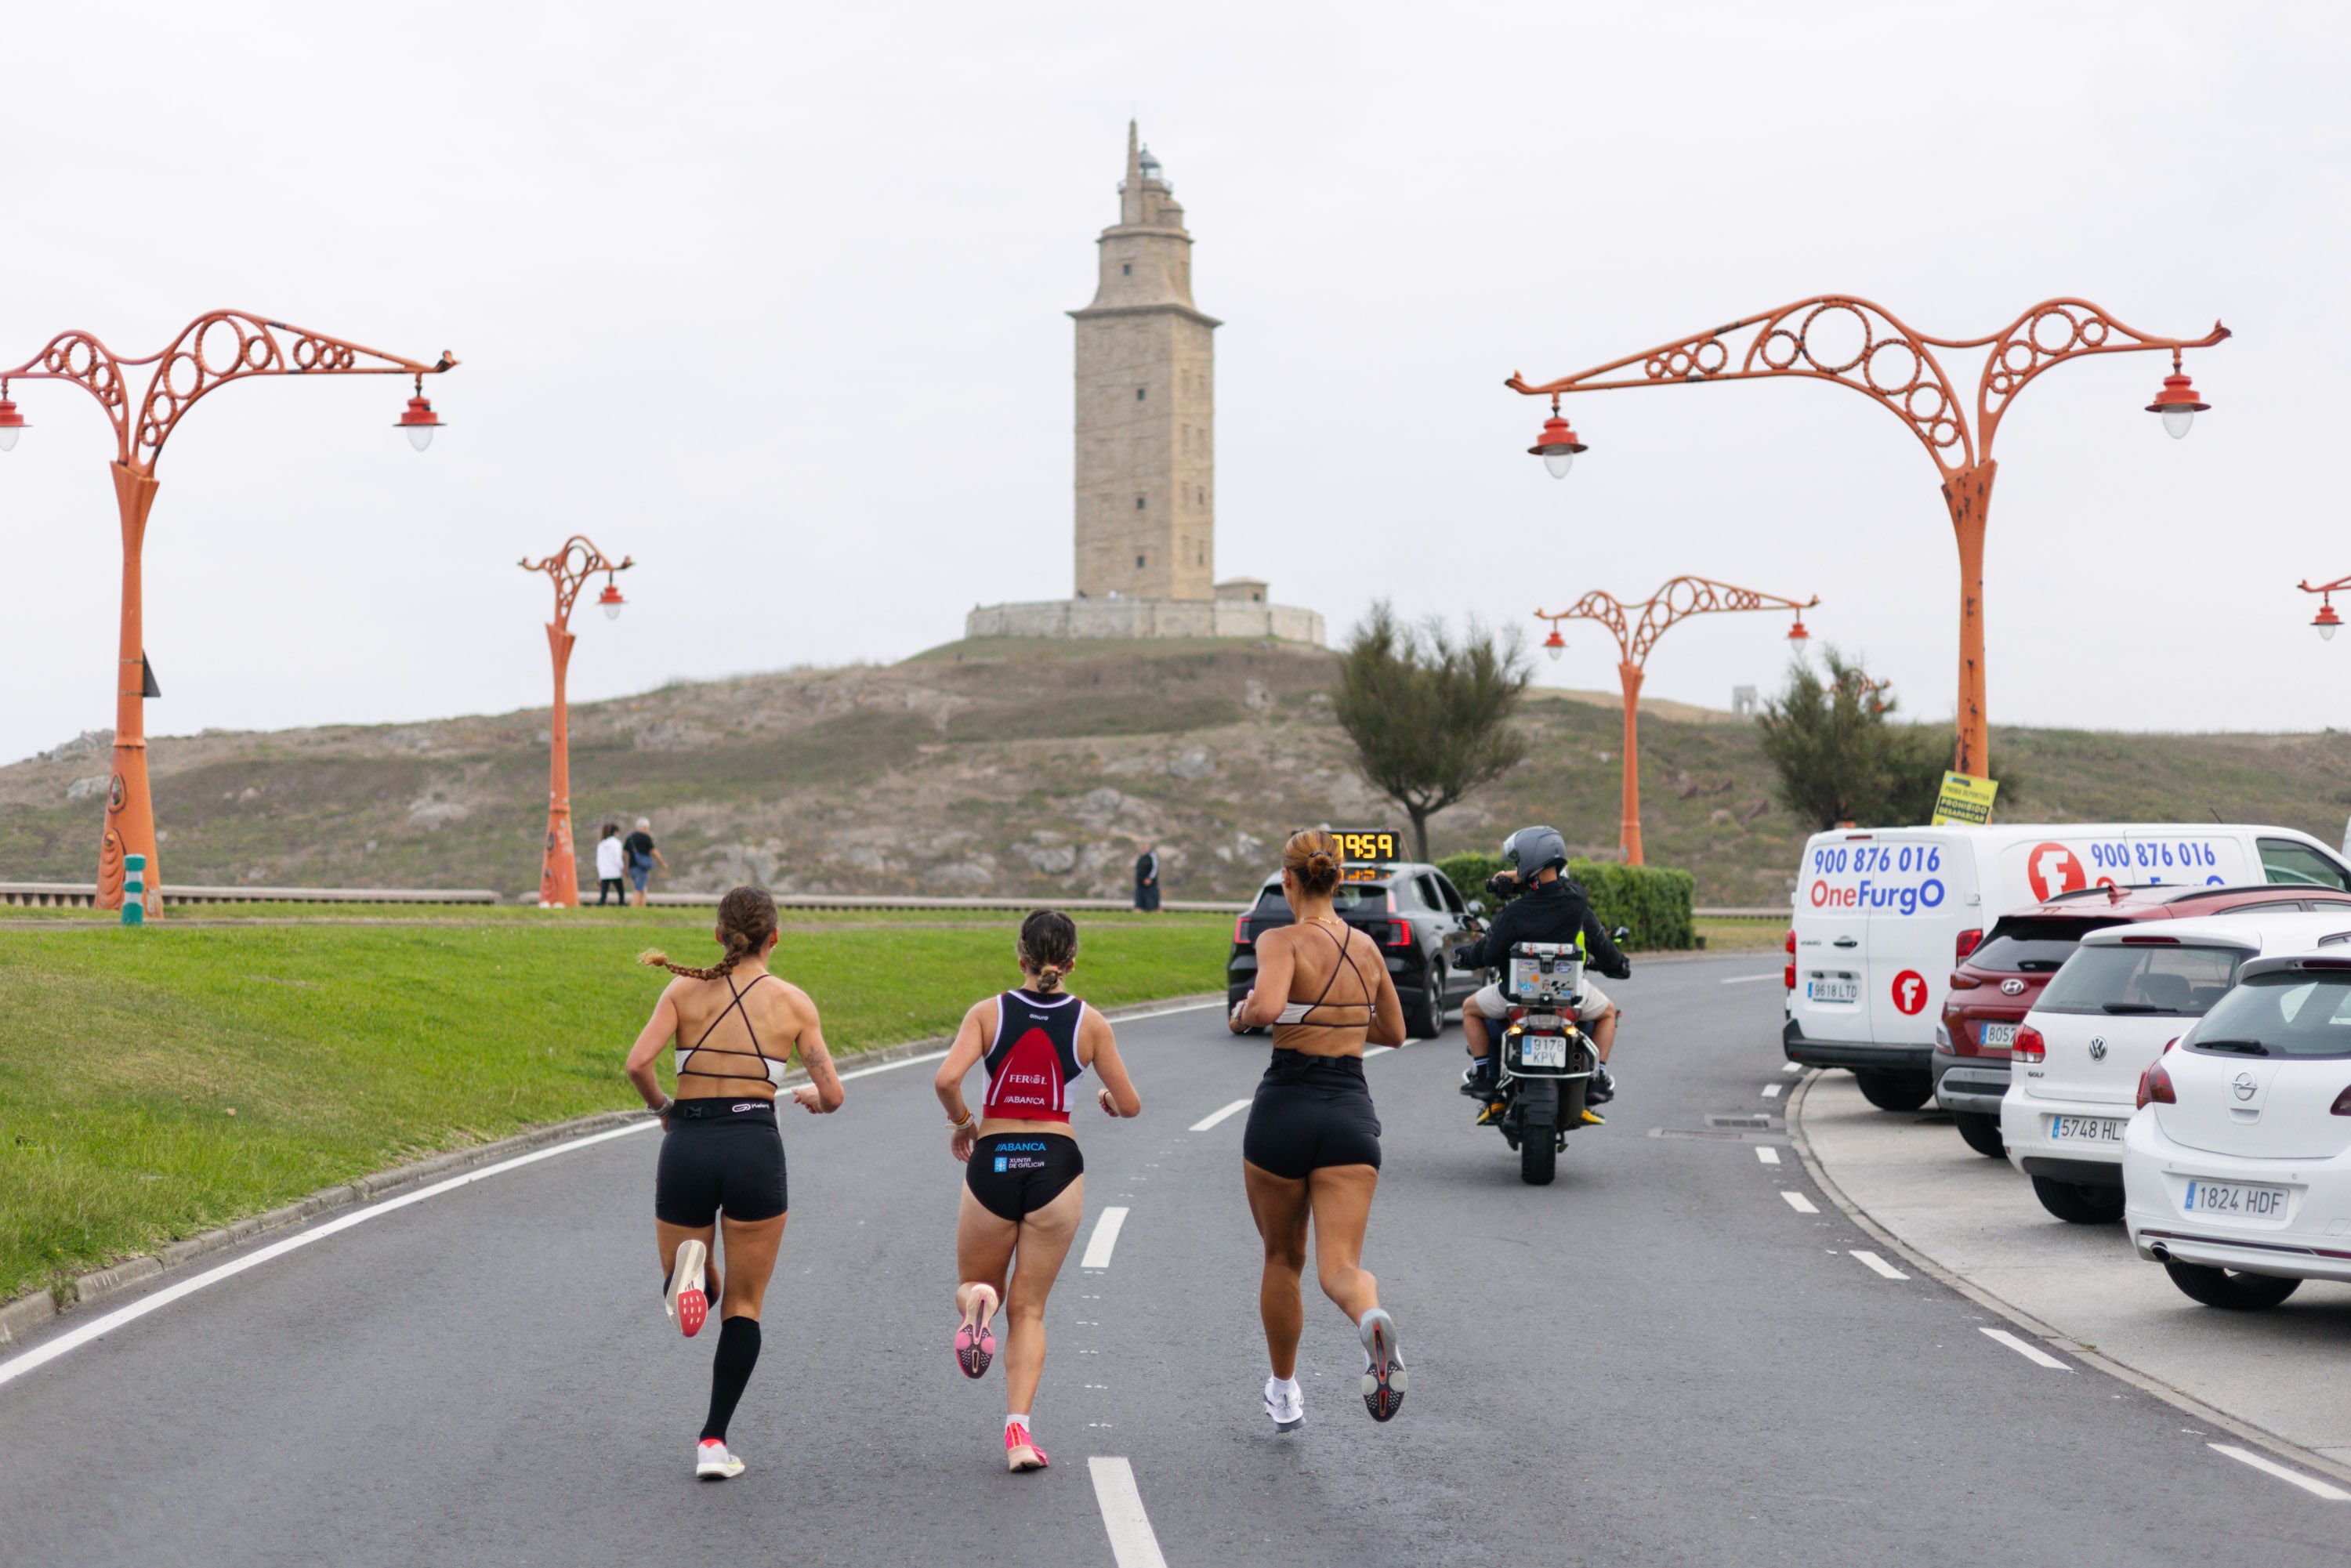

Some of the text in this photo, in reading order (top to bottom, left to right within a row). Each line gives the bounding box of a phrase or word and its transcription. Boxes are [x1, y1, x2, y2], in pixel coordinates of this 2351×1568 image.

[1938, 806, 1985, 823] DESAPARCAR
[1940, 798, 1987, 814] PROHIBIDO
[1815, 846, 1940, 875] 900 876 016
[2091, 842, 2215, 867] 900 876 016
[1811, 878, 1945, 915] OneFurgO
[1815, 984, 1857, 998] 9618 LTD
[1534, 1038, 1564, 1052] 9178
[2061, 1119, 2098, 1139] 5748
[2201, 1187, 2284, 1214] 1824 HDF
